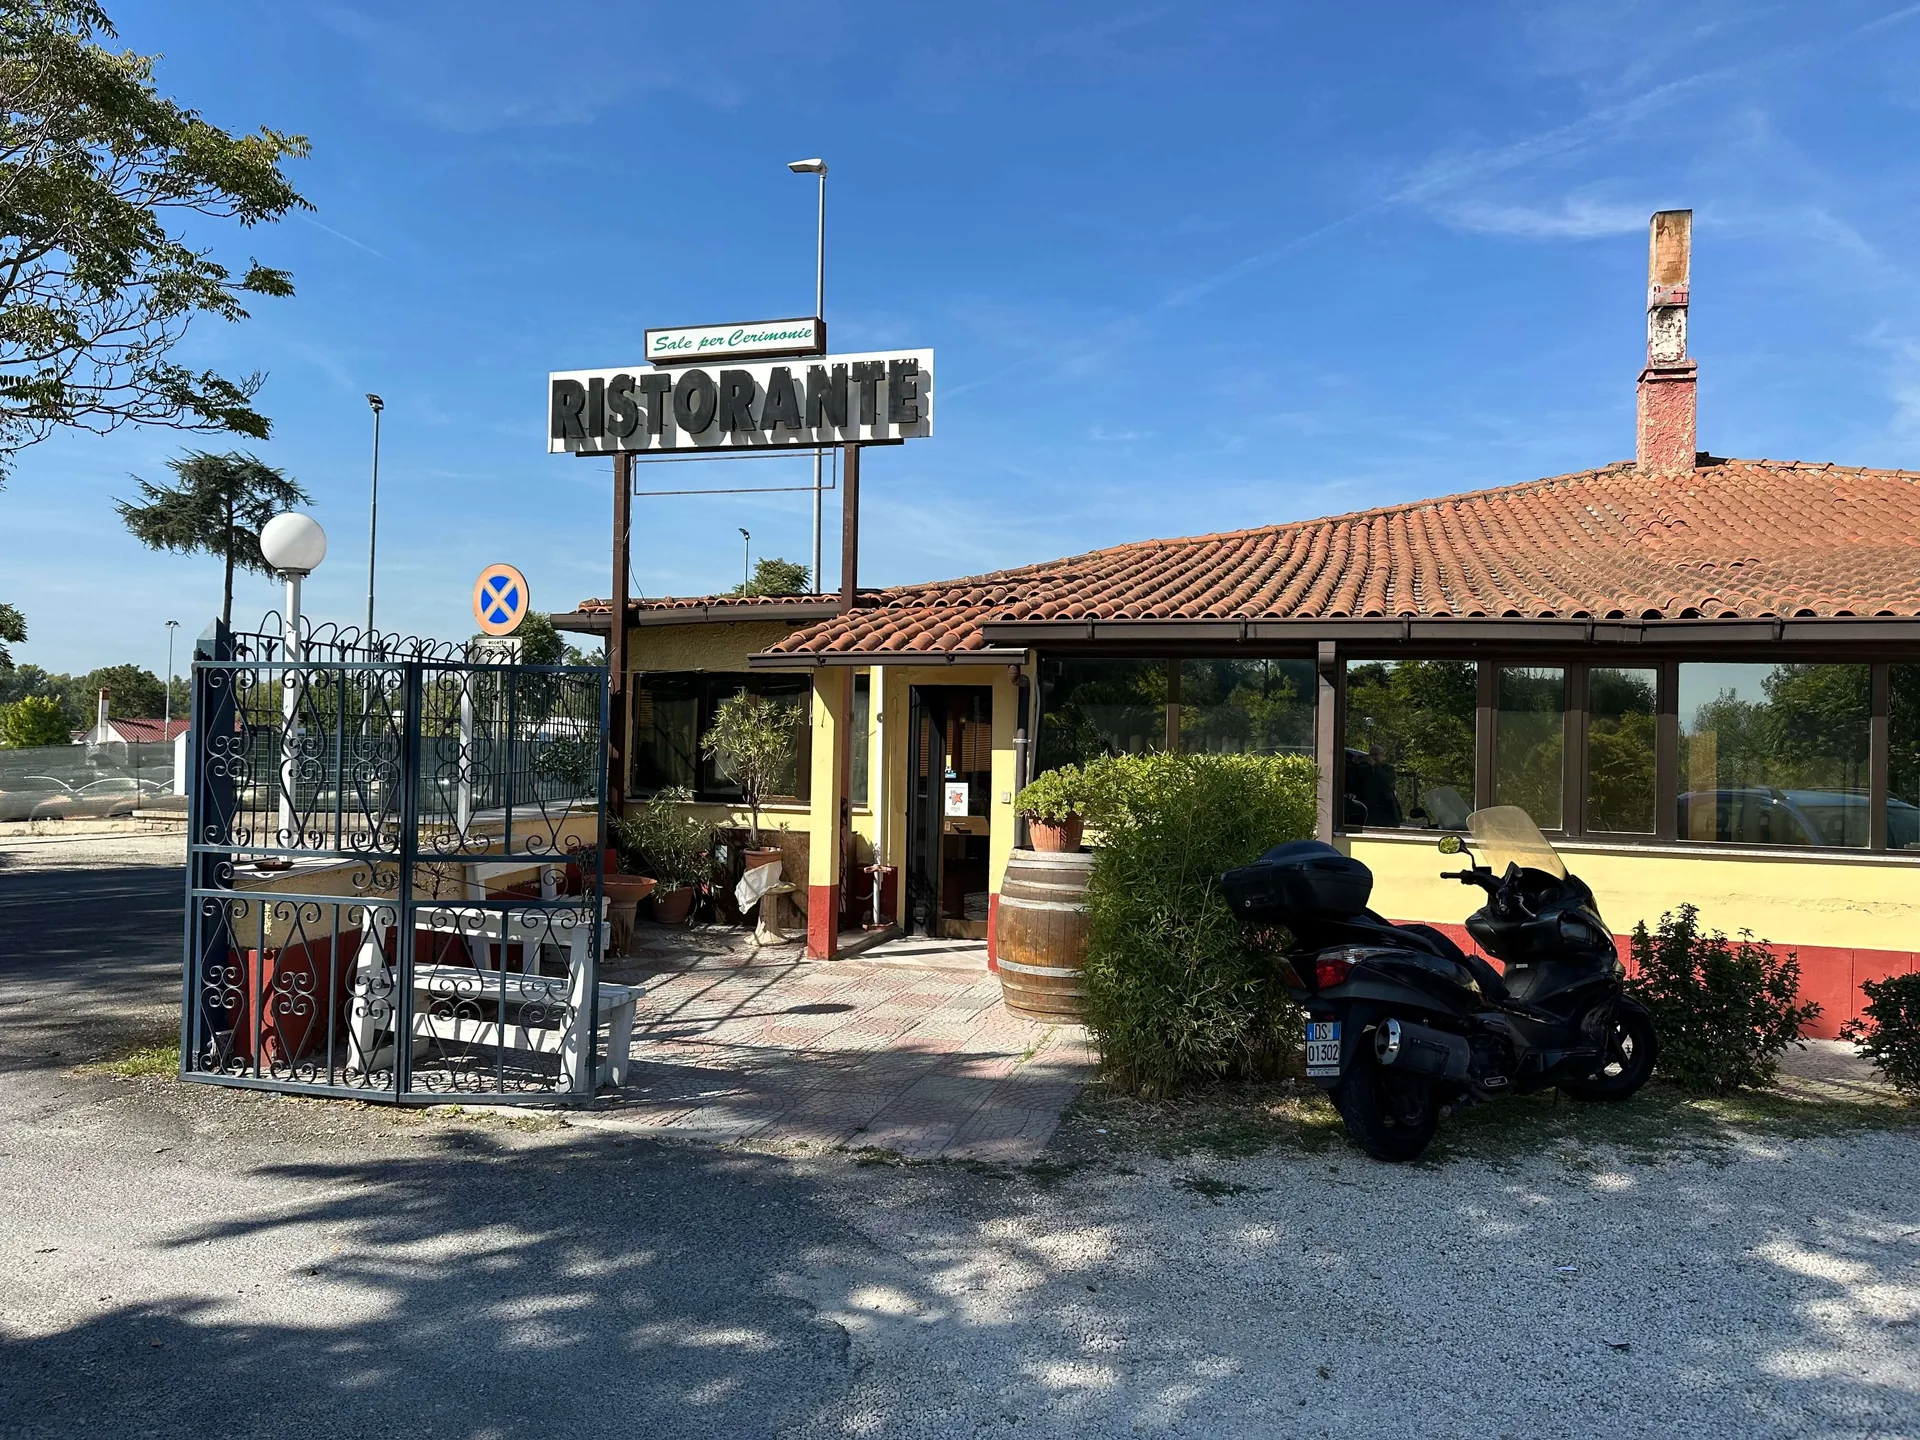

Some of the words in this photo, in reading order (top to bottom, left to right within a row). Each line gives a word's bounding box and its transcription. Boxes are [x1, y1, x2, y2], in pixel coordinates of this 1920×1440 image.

[653, 336, 692, 351] Sale
[698, 336, 725, 351] per
[728, 328, 812, 347] Cerimonie
[552, 358, 919, 439] RISTORANTE
[1315, 1024, 1327, 1039] DS
[1308, 1044, 1338, 1061] 01302
